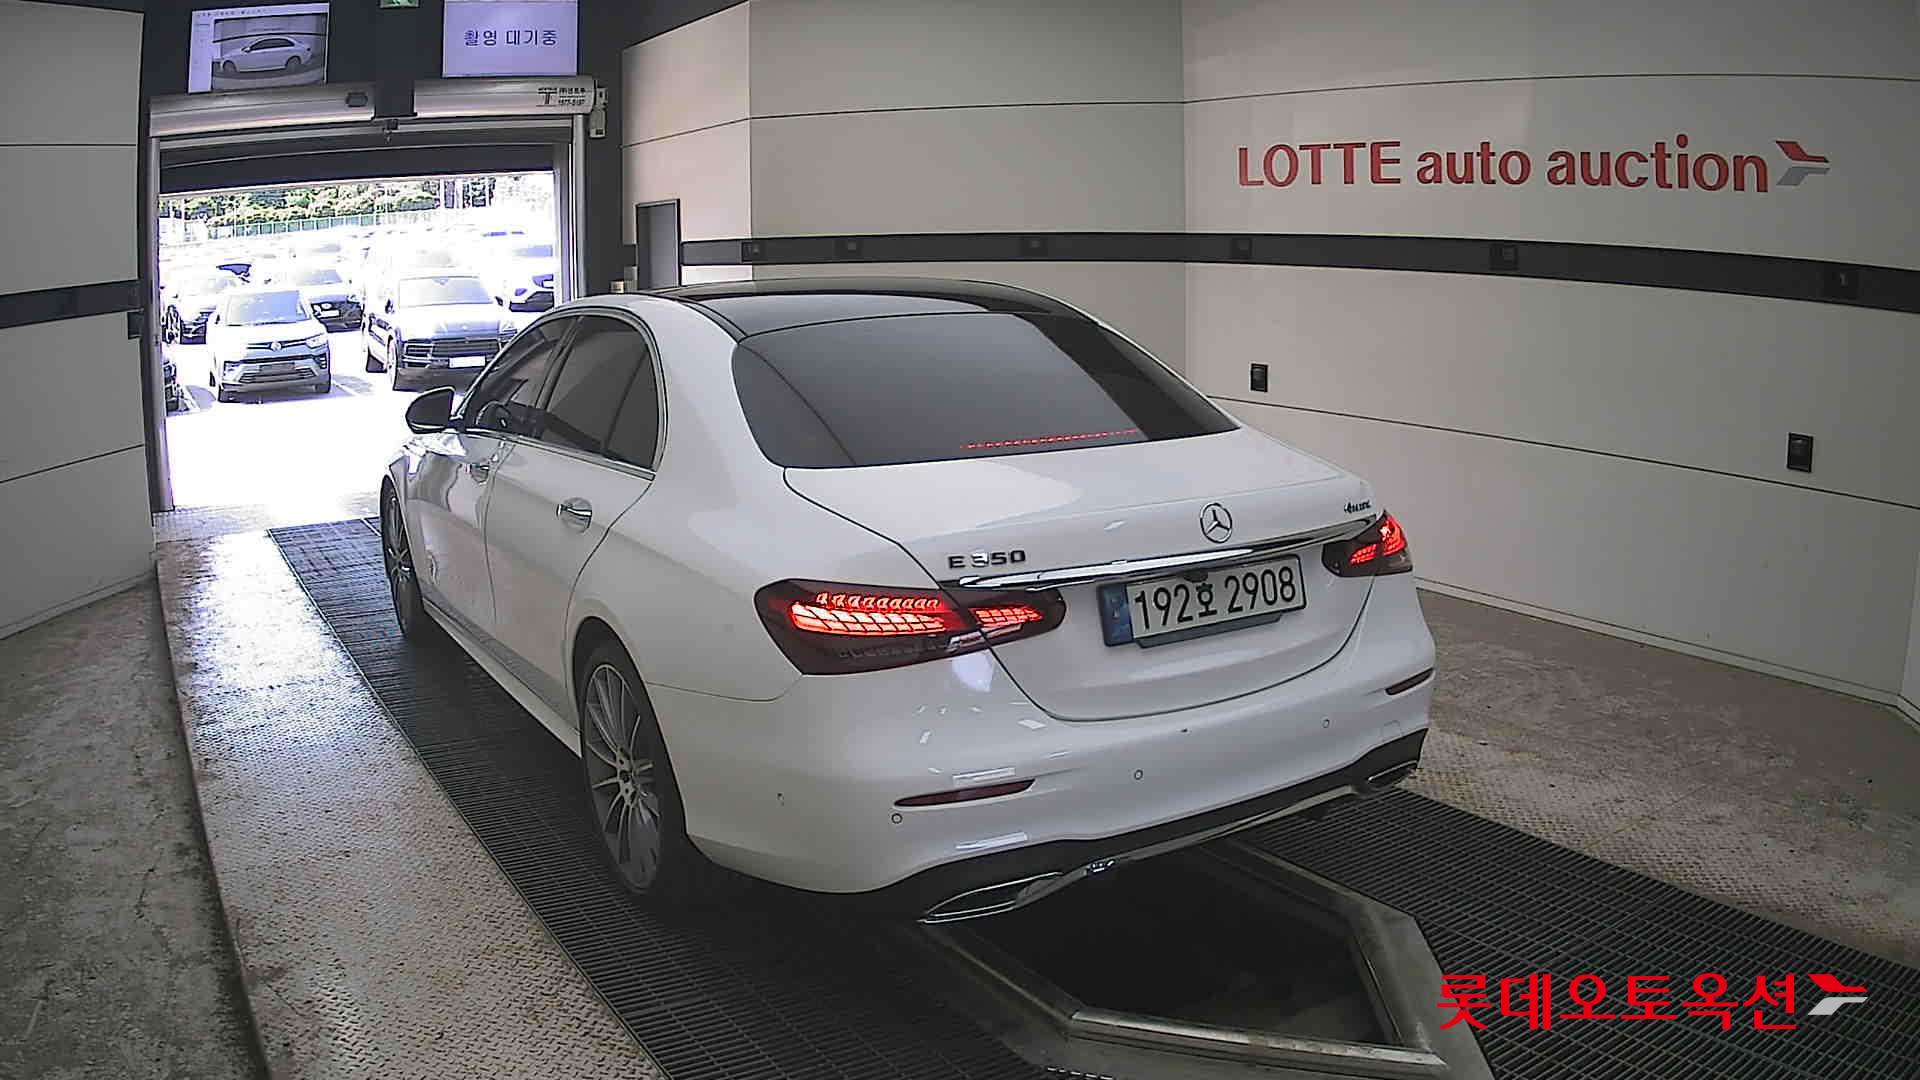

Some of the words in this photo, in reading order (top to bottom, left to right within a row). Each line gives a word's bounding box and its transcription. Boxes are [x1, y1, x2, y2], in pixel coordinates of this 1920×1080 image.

[506, 29, 557, 46] 대기중
[1237, 141, 1401, 188] LOTTE
[1416, 141, 1531, 186] auto
[1545, 133, 1769, 193] auction
